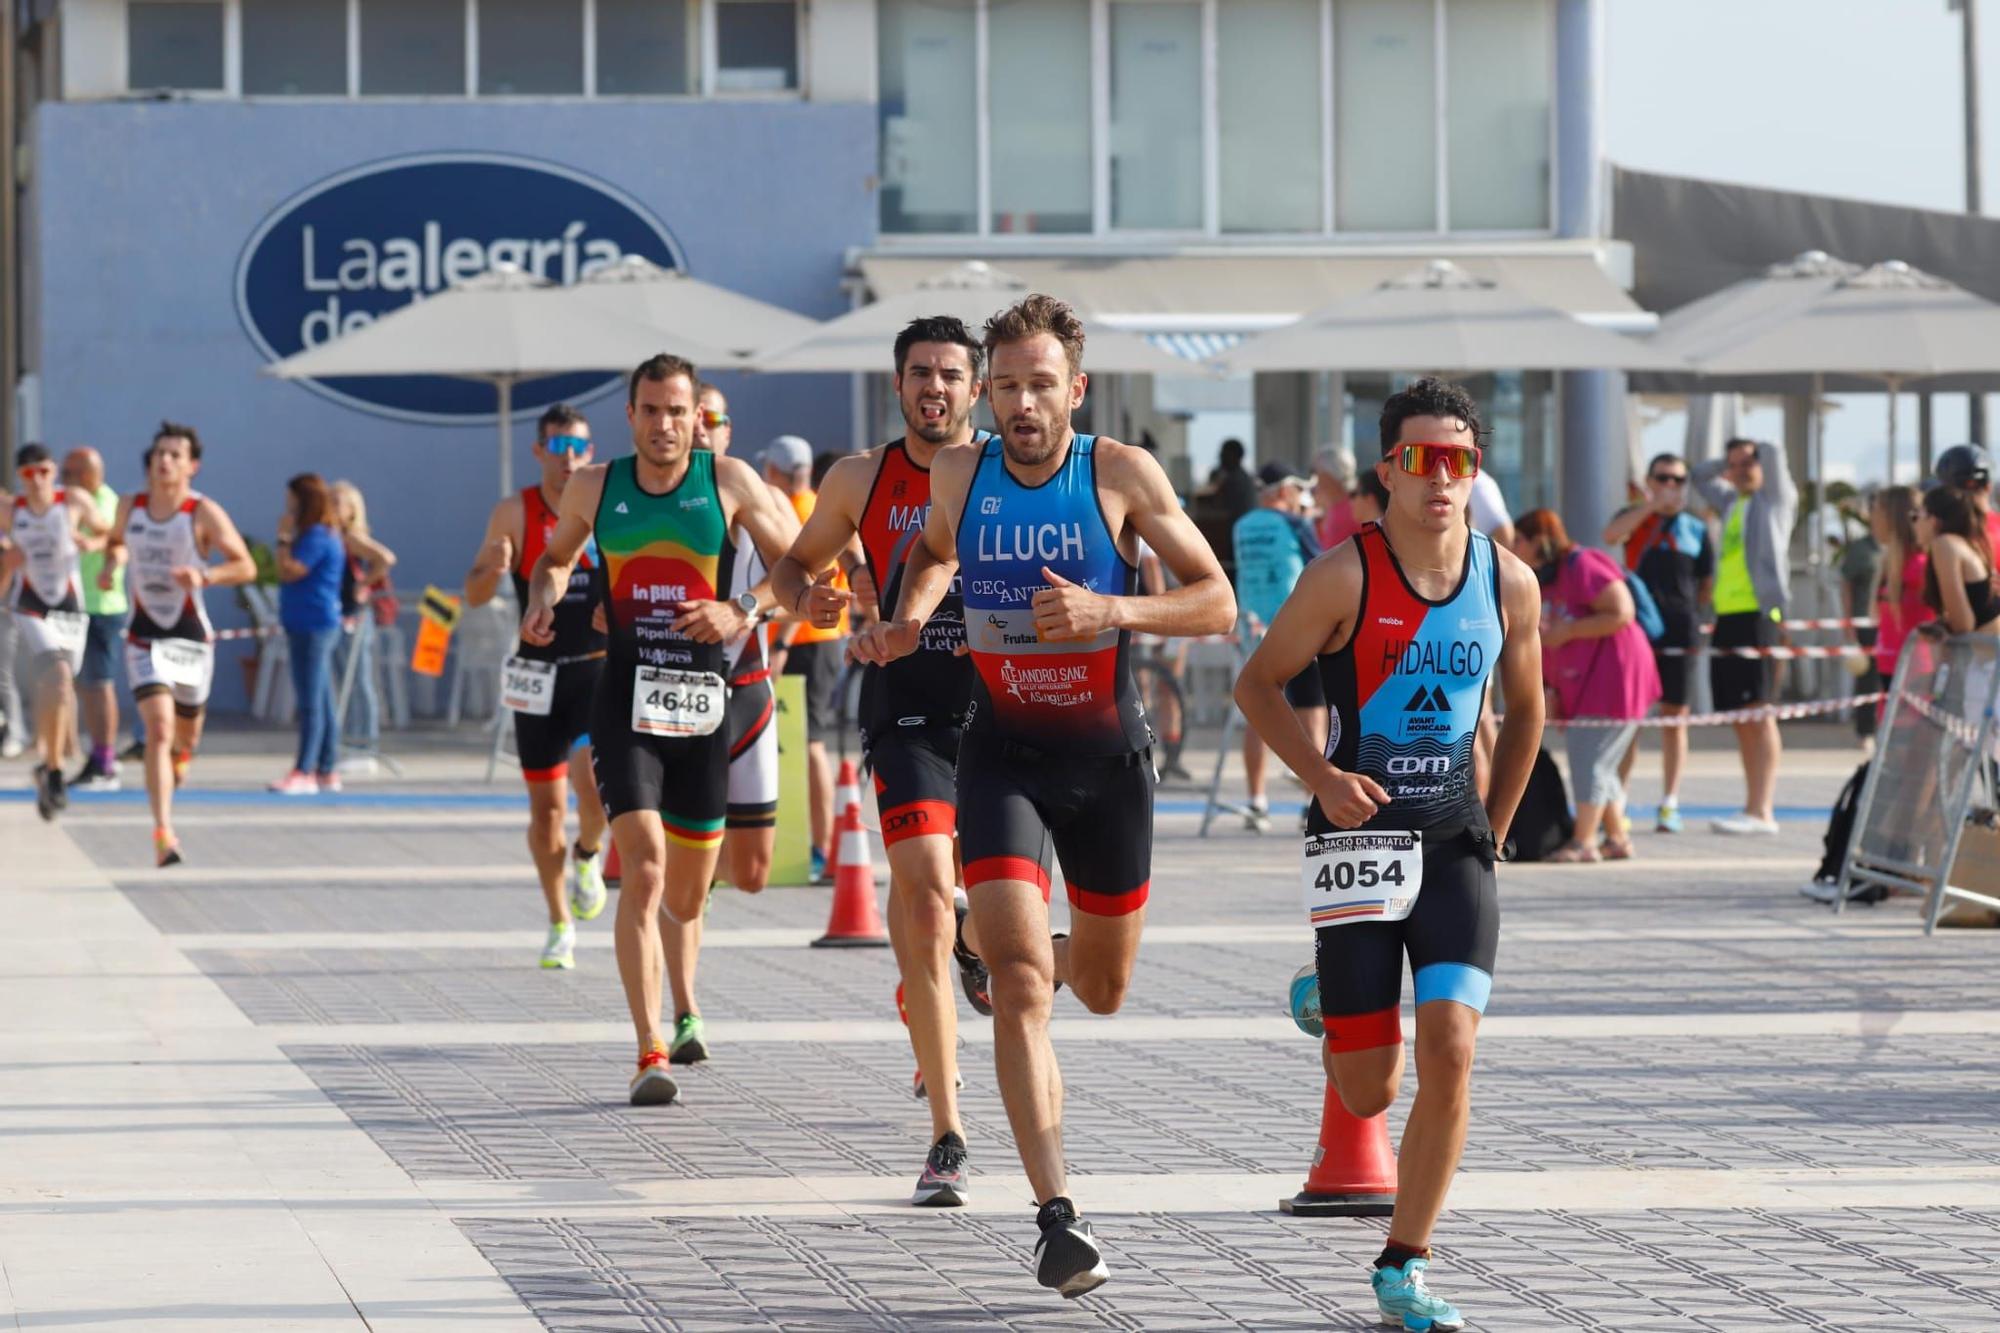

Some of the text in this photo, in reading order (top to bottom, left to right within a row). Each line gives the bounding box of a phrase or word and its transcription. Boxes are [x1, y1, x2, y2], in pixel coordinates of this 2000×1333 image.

[978, 522, 1085, 562] LLUCH
[972, 580, 1007, 595] CEC
[1003, 634, 1038, 644] Frutas
[1381, 640, 1483, 677] HIDALGO
[1060, 665, 1089, 681] SANZ
[646, 688, 710, 713] 4648
[1355, 837, 1369, 847] DE
[1314, 860, 1405, 893] 4054
